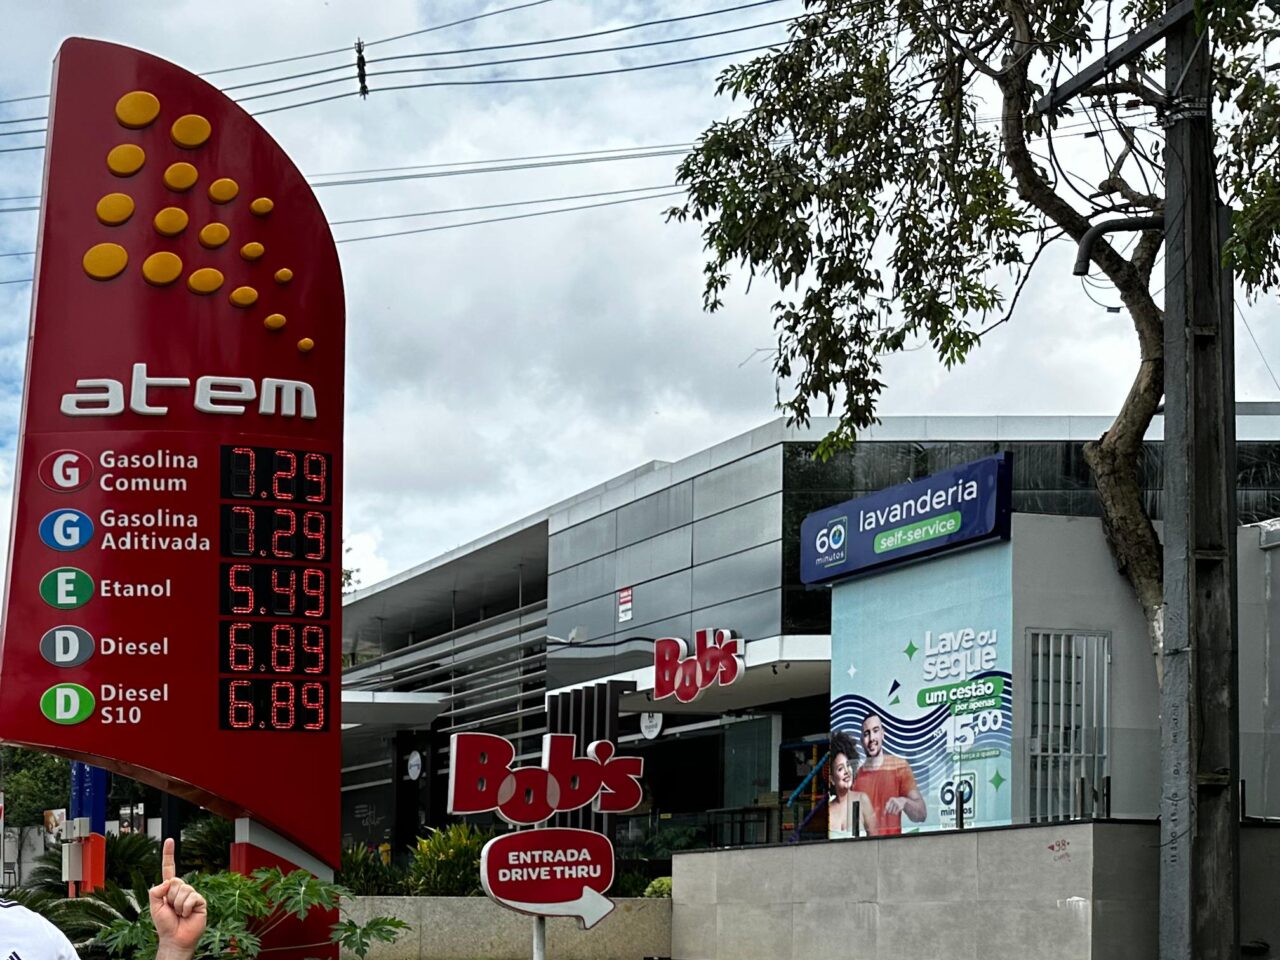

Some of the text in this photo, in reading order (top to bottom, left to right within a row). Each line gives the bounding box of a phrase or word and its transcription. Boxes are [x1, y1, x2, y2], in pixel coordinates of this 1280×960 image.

[60, 363, 317, 419] atem
[52, 454, 79, 488] G
[100, 450, 198, 469] Gasolina
[232, 448, 326, 502] 7.29
[100, 474, 187, 492] Comum
[100, 509, 198, 528] Gasolina
[859, 479, 977, 532] lavanderia
[53, 513, 80, 546] G
[101, 532, 210, 551] Aditivada
[232, 506, 325, 560] 7.29
[816, 524, 845, 553] 60
[880, 518, 955, 549] self-service
[816, 551, 844, 565] minutos
[57, 572, 77, 604] E
[100, 580, 171, 597] Etanol
[230, 564, 325, 617] 5.49
[55, 631, 79, 662] D
[101, 637, 169, 655] Diesel
[229, 623, 324, 673] 6.89
[925, 628, 997, 656] Lave ou
[654, 628, 744, 703] Bob's
[923, 646, 997, 682] seque
[56, 688, 80, 720] D
[101, 683, 169, 702] Diesel
[229, 680, 324, 730] 6.89
[926, 679, 994, 704] um cestão
[954, 698, 995, 713] por apenas
[101, 706, 141, 724] S10
[447, 732, 644, 825] Bob's
[508, 848, 591, 865] ENTRADA
[498, 865, 601, 882] DRIVE THRU
